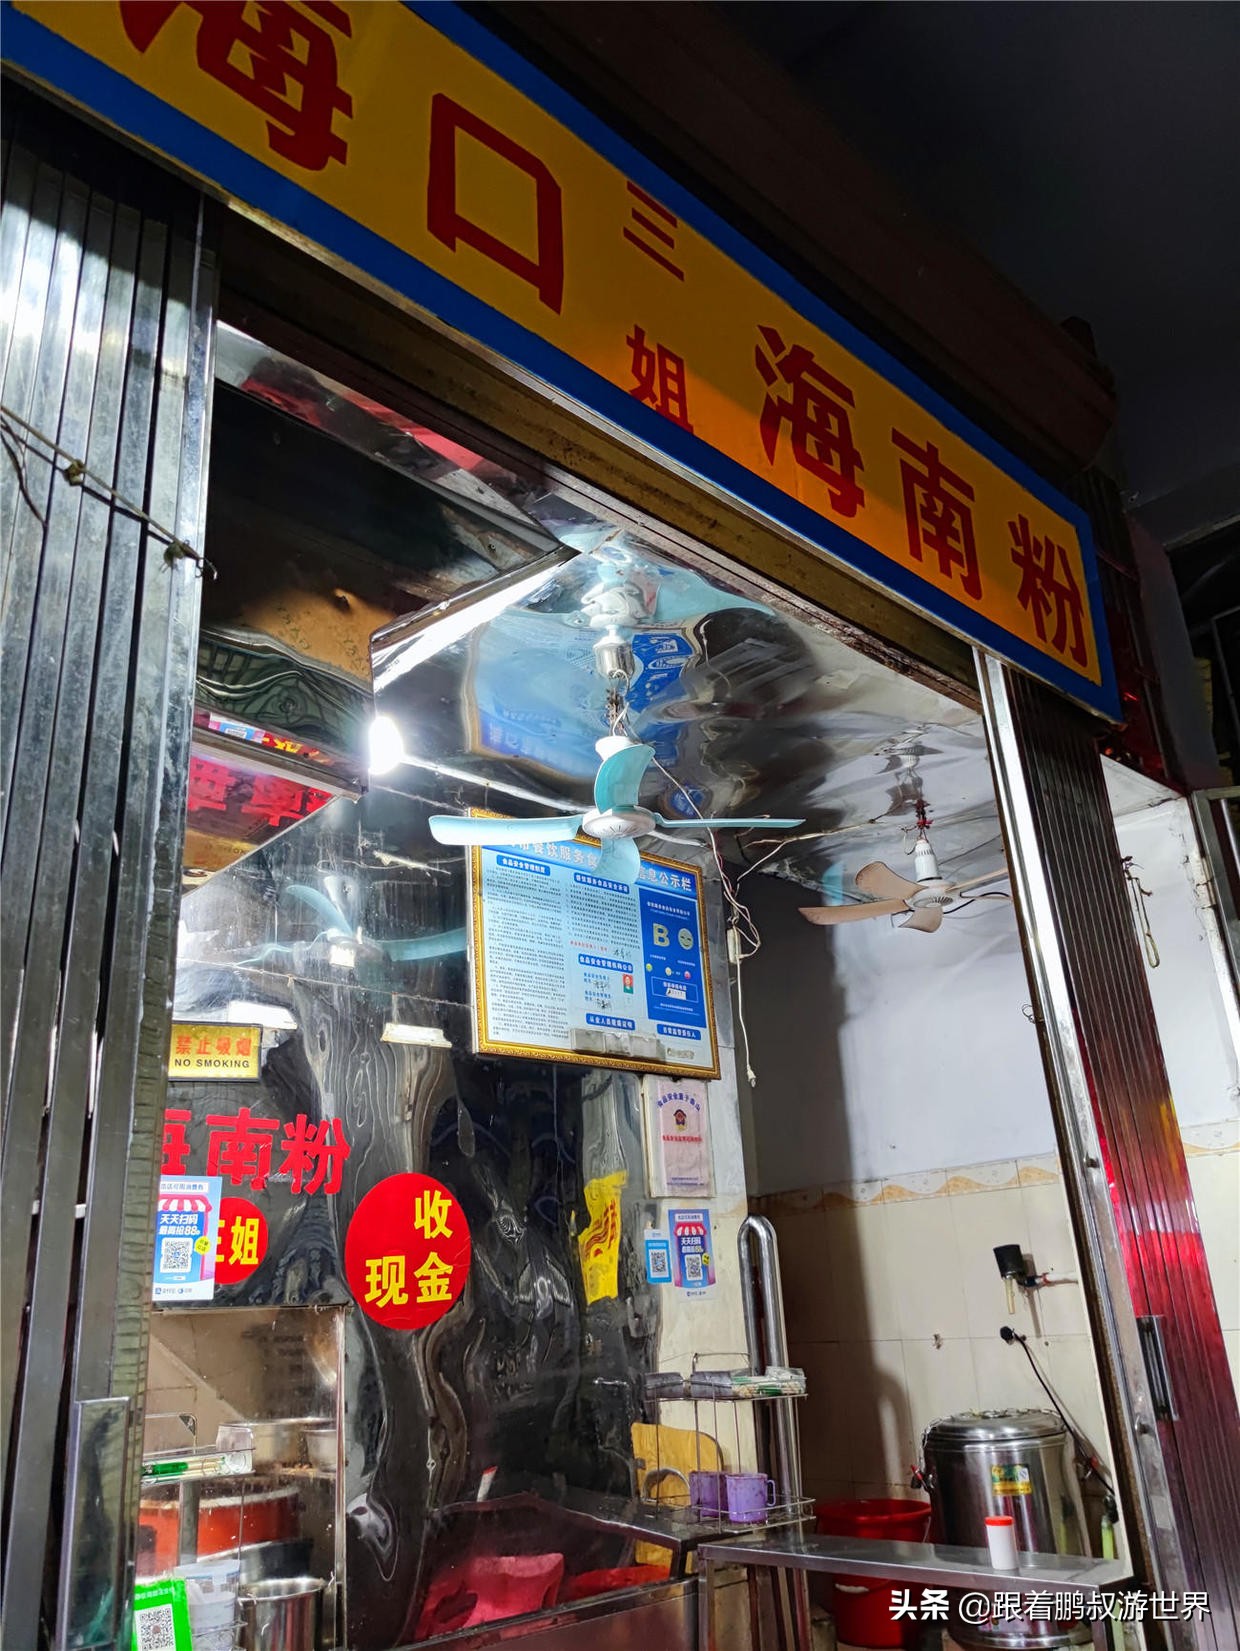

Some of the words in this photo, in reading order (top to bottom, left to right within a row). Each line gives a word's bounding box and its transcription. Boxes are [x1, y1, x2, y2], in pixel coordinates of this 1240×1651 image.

[622, 180, 694, 434] 三姐
[754, 324, 1088, 668] 海南粉
[653, 922, 670, 948] B
[175, 1035, 252, 1056] 禁止吸烟
[174, 1058, 191, 1067] NO
[196, 1058, 250, 1068] SMOKING
[160, 1213, 199, 1225] 天天扫码
[414, 1189, 453, 1240] 收
[364, 1251, 453, 1308] 现金
